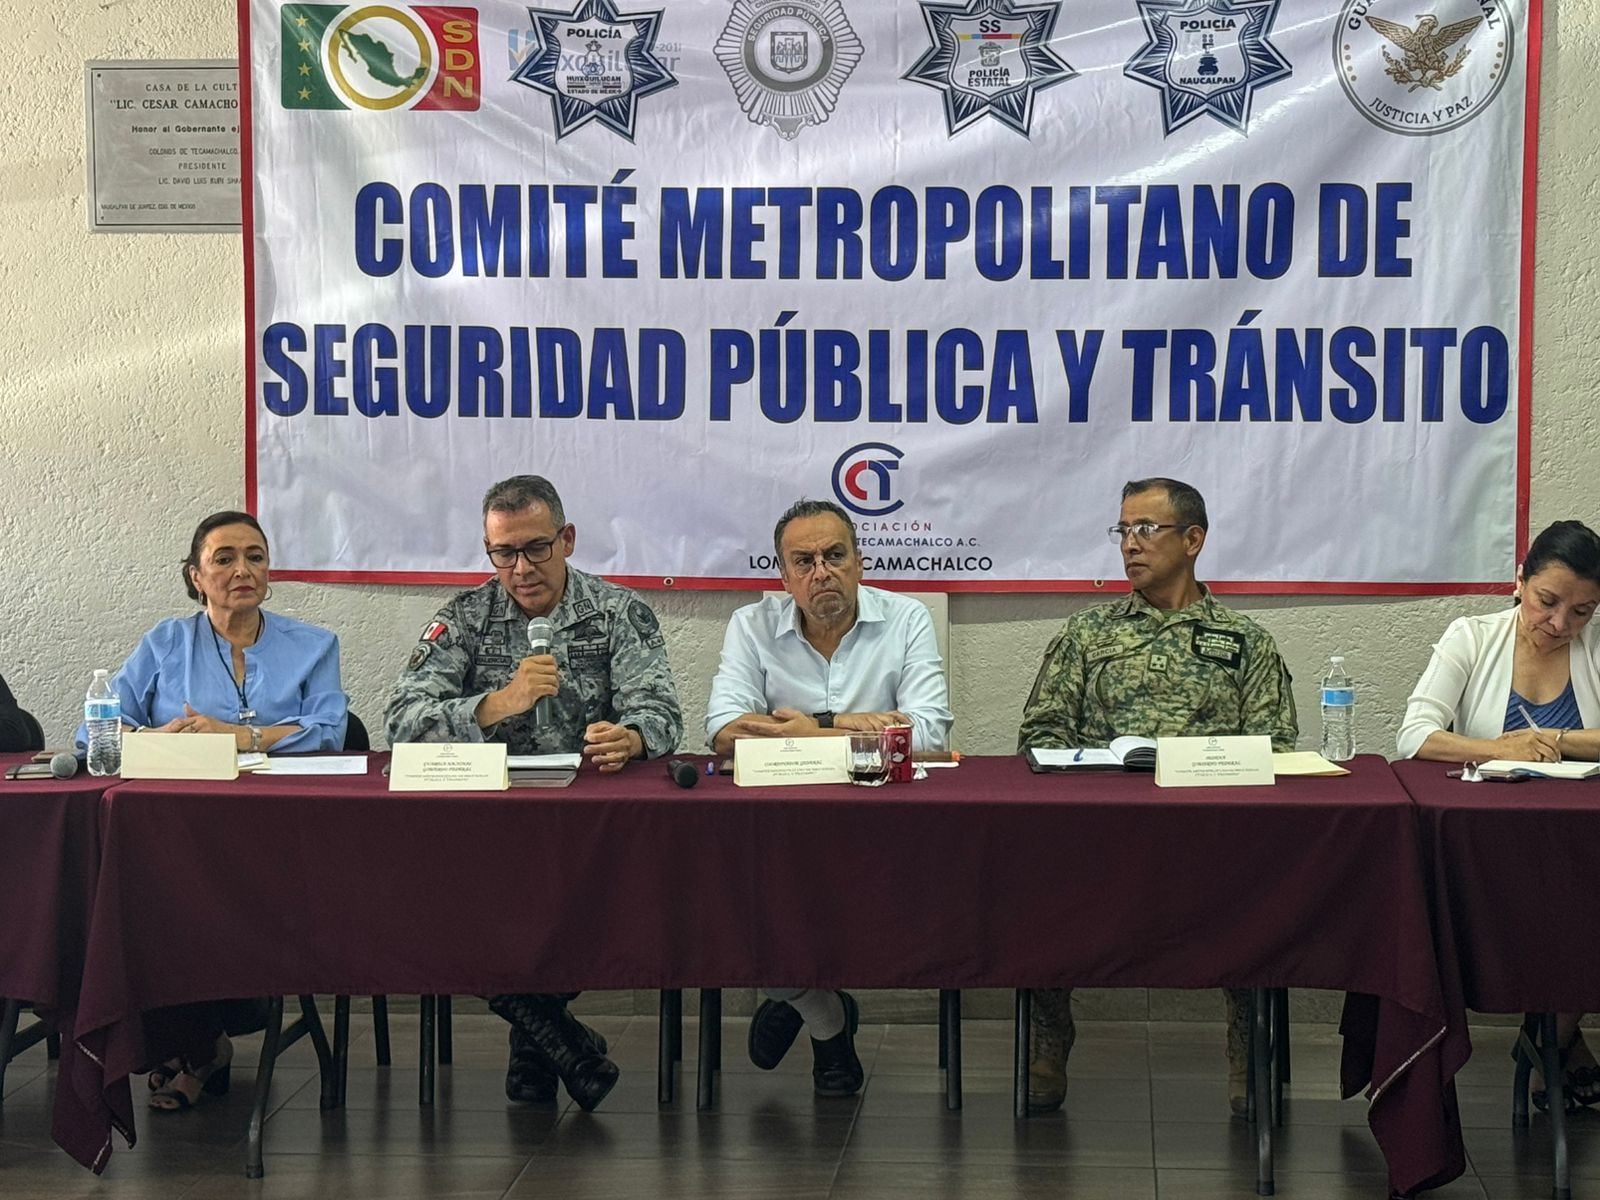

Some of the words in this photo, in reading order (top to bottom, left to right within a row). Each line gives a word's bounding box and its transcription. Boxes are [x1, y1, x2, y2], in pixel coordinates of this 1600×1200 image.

[747, 7, 794, 41] SEGURIDAD
[796, 8, 830, 43] PUBLICA
[979, 20, 1001, 33] SS
[1180, 18, 1236, 30] POLICÍA
[567, 26, 622, 39] POLICÍA
[442, 20, 474, 98] SDN
[969, 67, 1010, 77] POLICÍA
[968, 77, 1011, 87] ESTATAL
[1179, 77, 1236, 85] NAUCALPAN
[145, 83, 172, 92] CASA
[177, 83, 190, 92] DE
[195, 83, 208, 91] LA
[212, 83, 238, 91] CULT
[142, 99, 179, 109] CESAR
[184, 99, 238, 109] CAMACHO
[1369, 97, 1430, 124] JUSTICIA
[1433, 110, 1443, 122] Y
[1446, 96, 1473, 118] PAZ
[131, 125, 157, 133] Honor
[162, 125, 170, 133] al
[175, 125, 226, 133] Gobernante
[178, 162, 227, 170] PRESIDENTE
[355, 168, 638, 280] COMITÉ
[660, 182, 1295, 281] METROPOLITANO
[1317, 182, 1413, 278] DE
[262, 321, 687, 421] SEGURIDAD
[709, 310, 1039, 424] PÚBLICA
[1056, 329, 1105, 423] Y
[1122, 309, 1510, 425] TRÁNSITO
